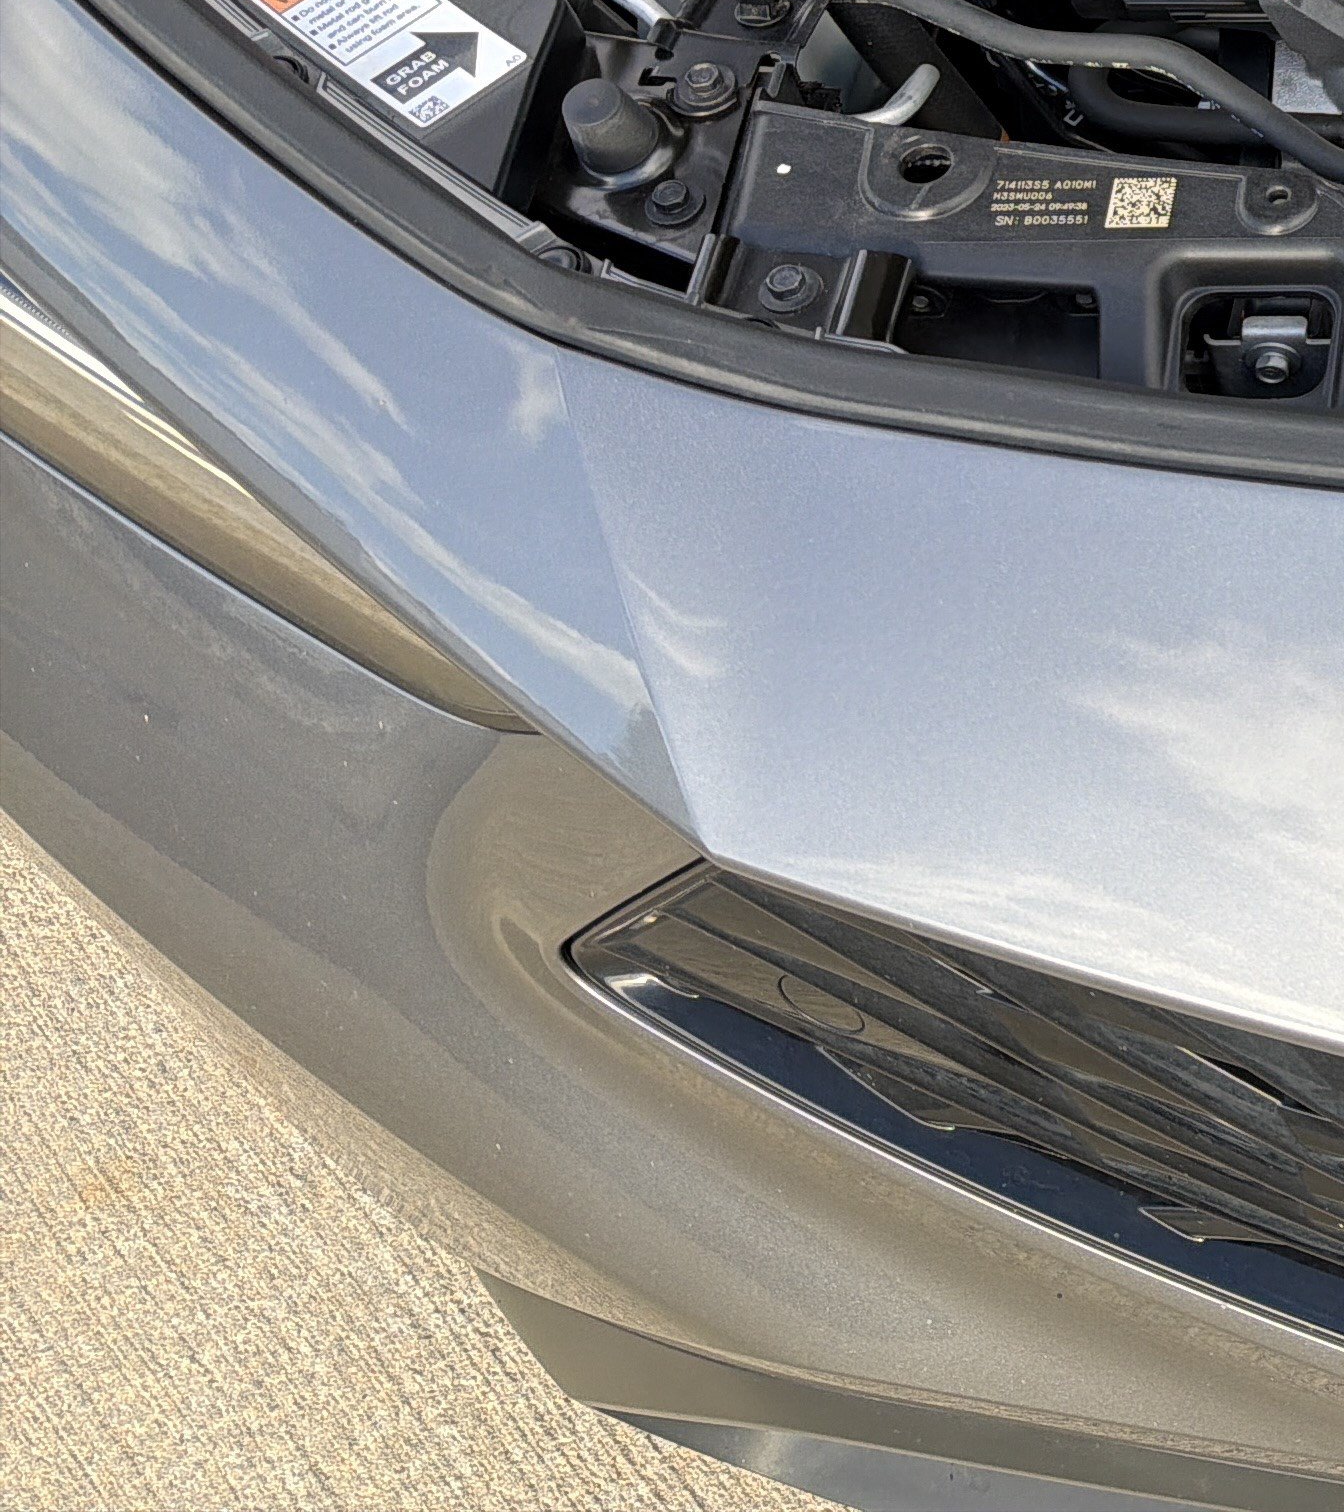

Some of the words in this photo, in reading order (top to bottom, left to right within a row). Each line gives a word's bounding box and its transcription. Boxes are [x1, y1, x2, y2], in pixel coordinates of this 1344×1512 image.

[385, 51, 437, 86] GRAB
[396, 58, 450, 97] FOAM
[990, 203, 1047, 212] 2023-05-24
[994, 215, 1020, 226] SN:
[1023, 215, 1089, 226] B0035551
